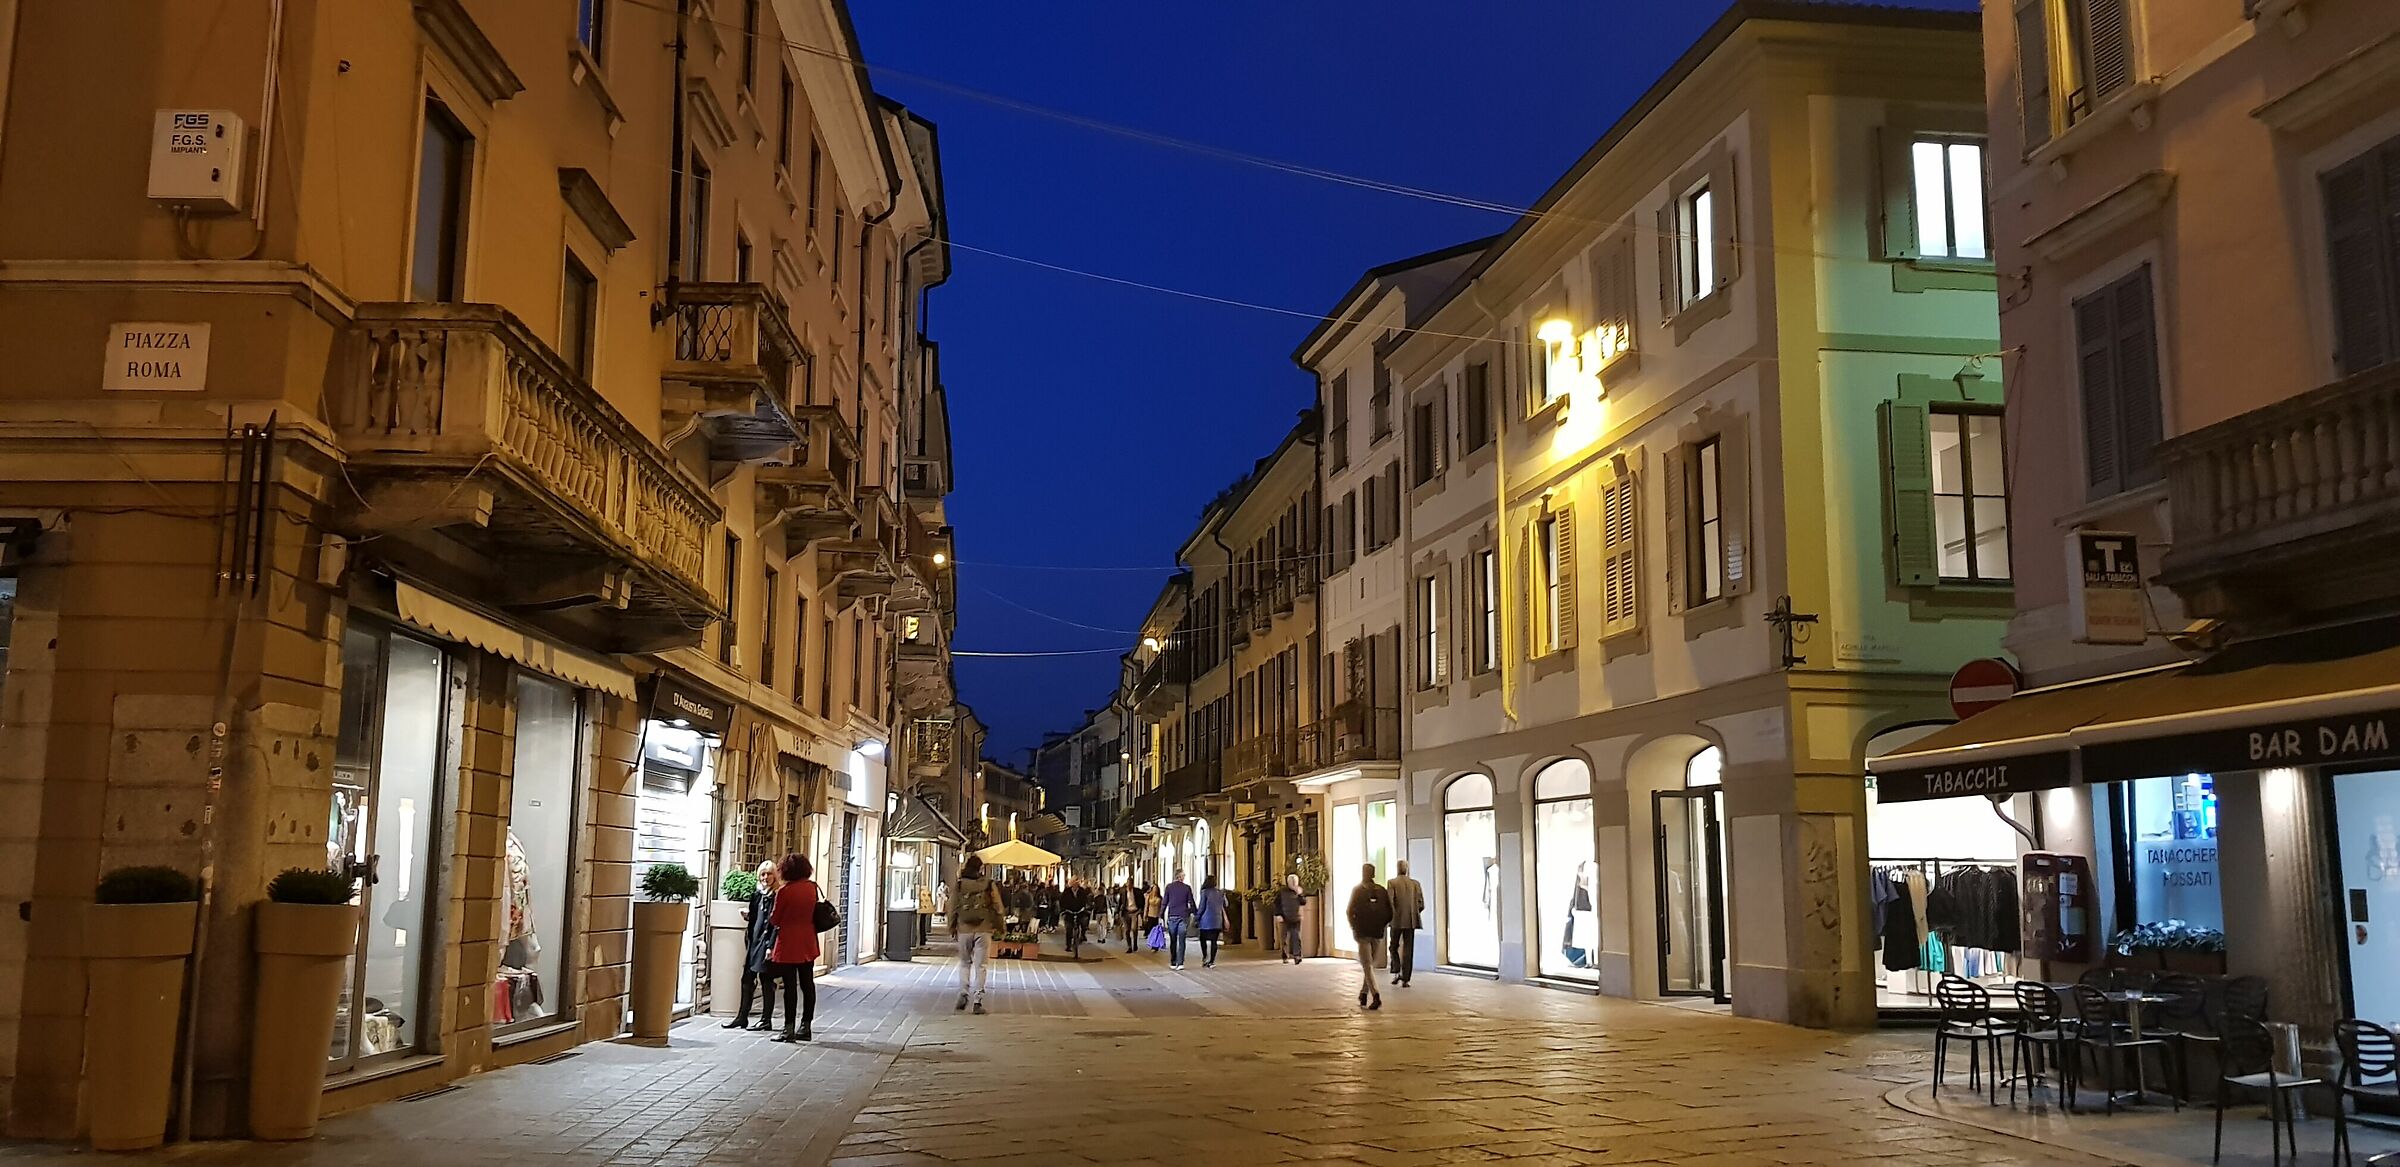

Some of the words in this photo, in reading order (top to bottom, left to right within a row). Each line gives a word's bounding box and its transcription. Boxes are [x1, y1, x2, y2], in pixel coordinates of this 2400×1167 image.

[174, 113, 209, 125] FGS
[171, 134, 207, 146] F.G.S.
[123, 332, 191, 349] PIAZZA
[127, 361, 182, 378] ROMA
[2094, 540, 2122, 573] T
[2248, 728, 2303, 761] BAR
[2317, 719, 2390, 756] DAM
[1924, 765, 2009, 795] TABACCHI
[2162, 871, 2212, 887] FOSSATI
